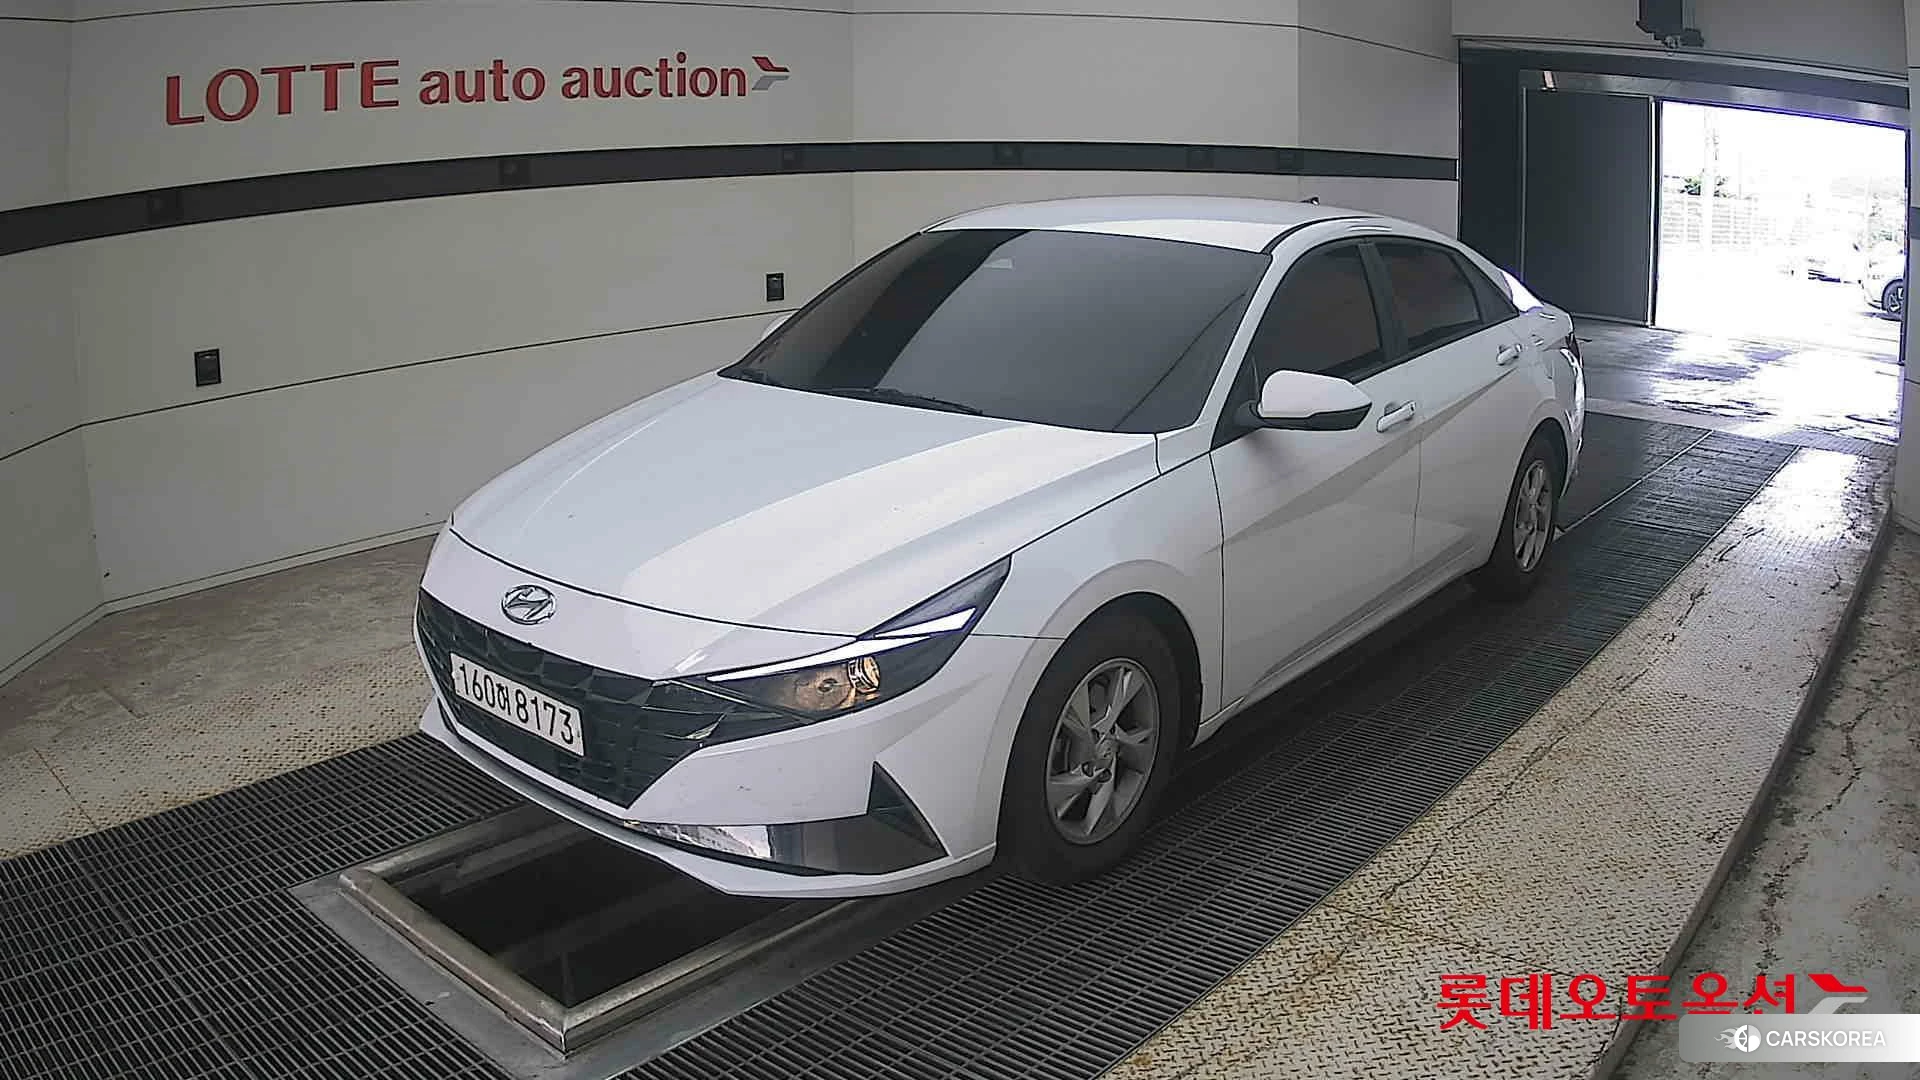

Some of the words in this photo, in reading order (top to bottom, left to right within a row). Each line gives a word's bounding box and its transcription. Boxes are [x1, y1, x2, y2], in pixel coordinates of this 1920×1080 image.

[166, 60, 400, 126] LOTTE
[419, 59, 546, 105] auto
[561, 51, 747, 99] auction
